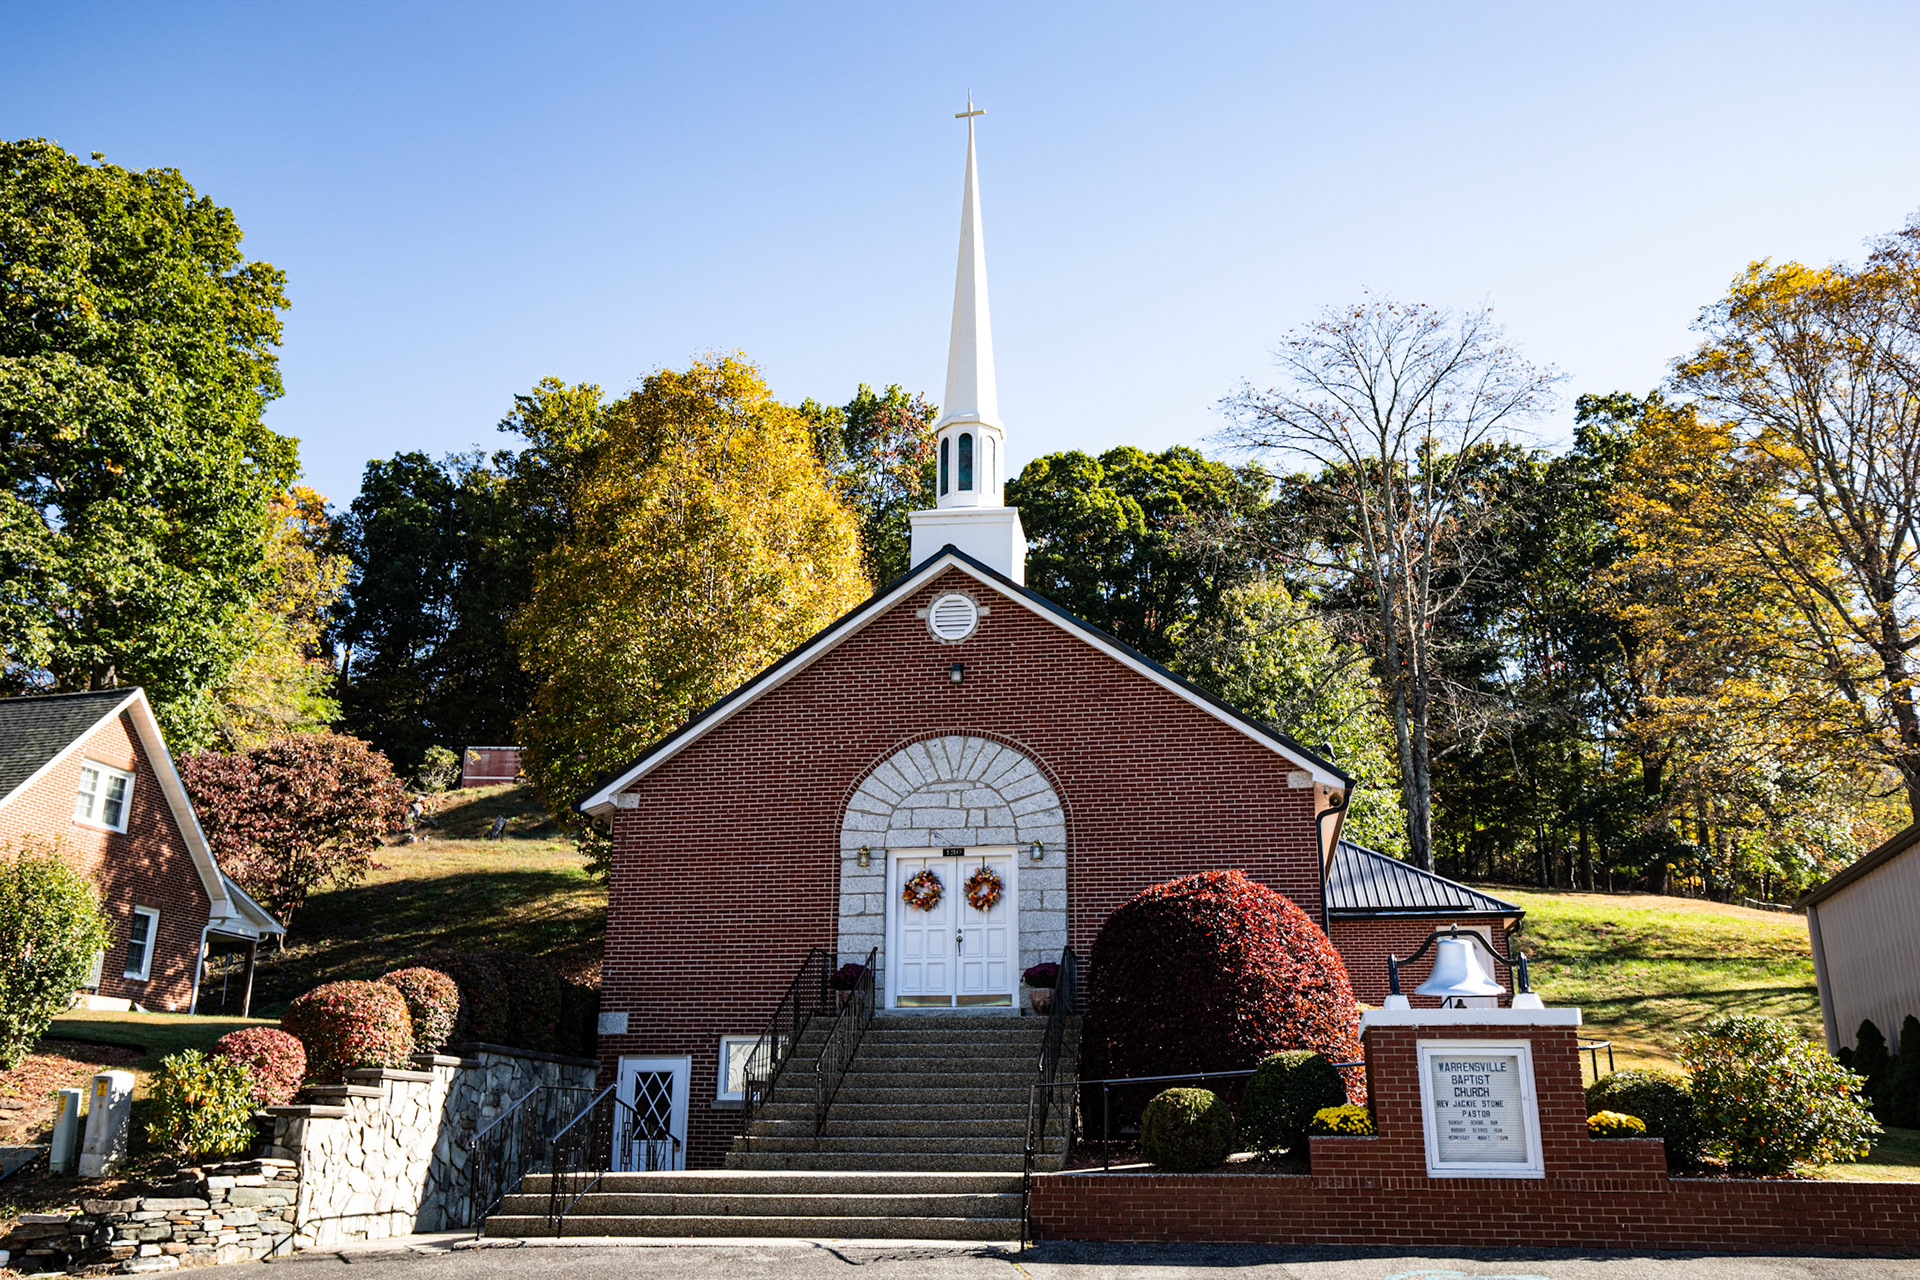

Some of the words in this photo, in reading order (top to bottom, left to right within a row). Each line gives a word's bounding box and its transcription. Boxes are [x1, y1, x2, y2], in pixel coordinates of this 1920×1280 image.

[1438, 1062, 1507, 1072] WARRENSVILLE
[1451, 1075, 1490, 1085] BAPTIST
[1454, 1087, 1490, 1097] CHURCH
[1436, 1100, 1449, 1108] REV
[1452, 1100, 1477, 1108] JACKIE
[1481, 1100, 1504, 1108] STONE
[1462, 1110, 1491, 1118] PASTOR
